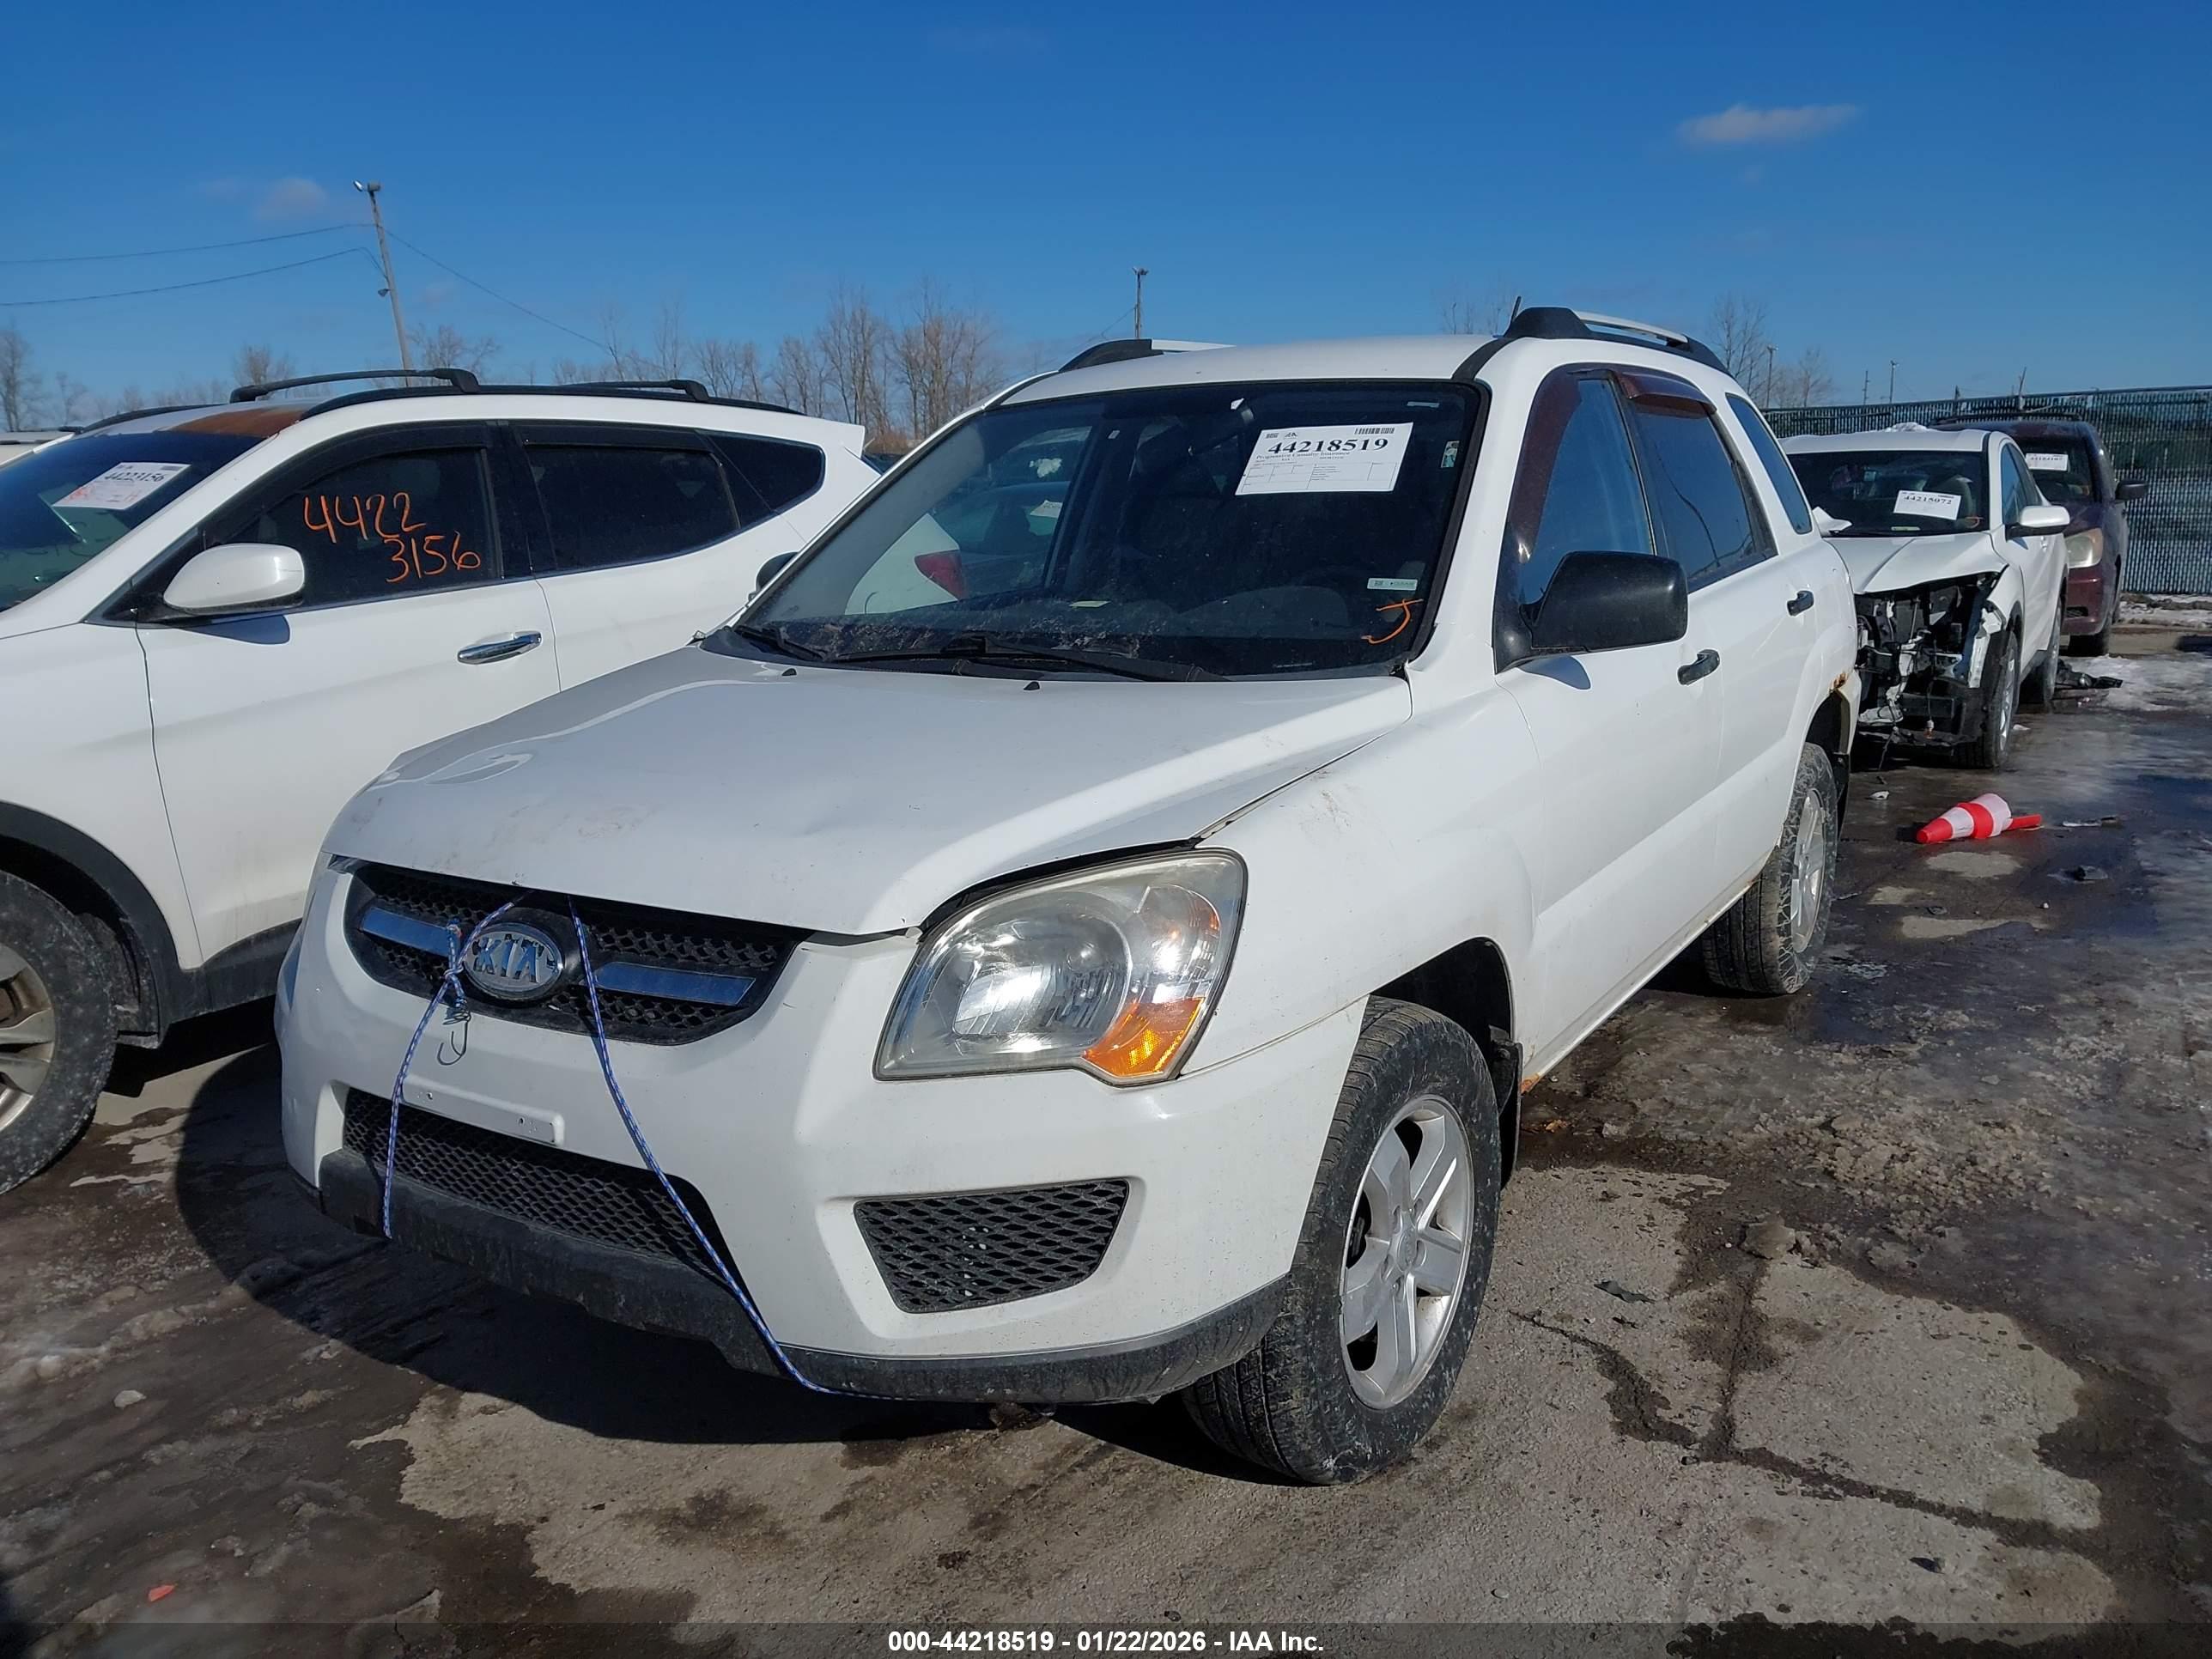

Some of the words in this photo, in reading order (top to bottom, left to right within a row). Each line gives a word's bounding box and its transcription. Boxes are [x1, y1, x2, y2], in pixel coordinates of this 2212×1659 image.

[1267, 438, 1389, 453] 44218519
[303, 492, 427, 544] 4422
[1904, 495, 1952, 505] 44215072
[384, 530, 481, 583] 3156
[472, 933, 540, 983] KIA
